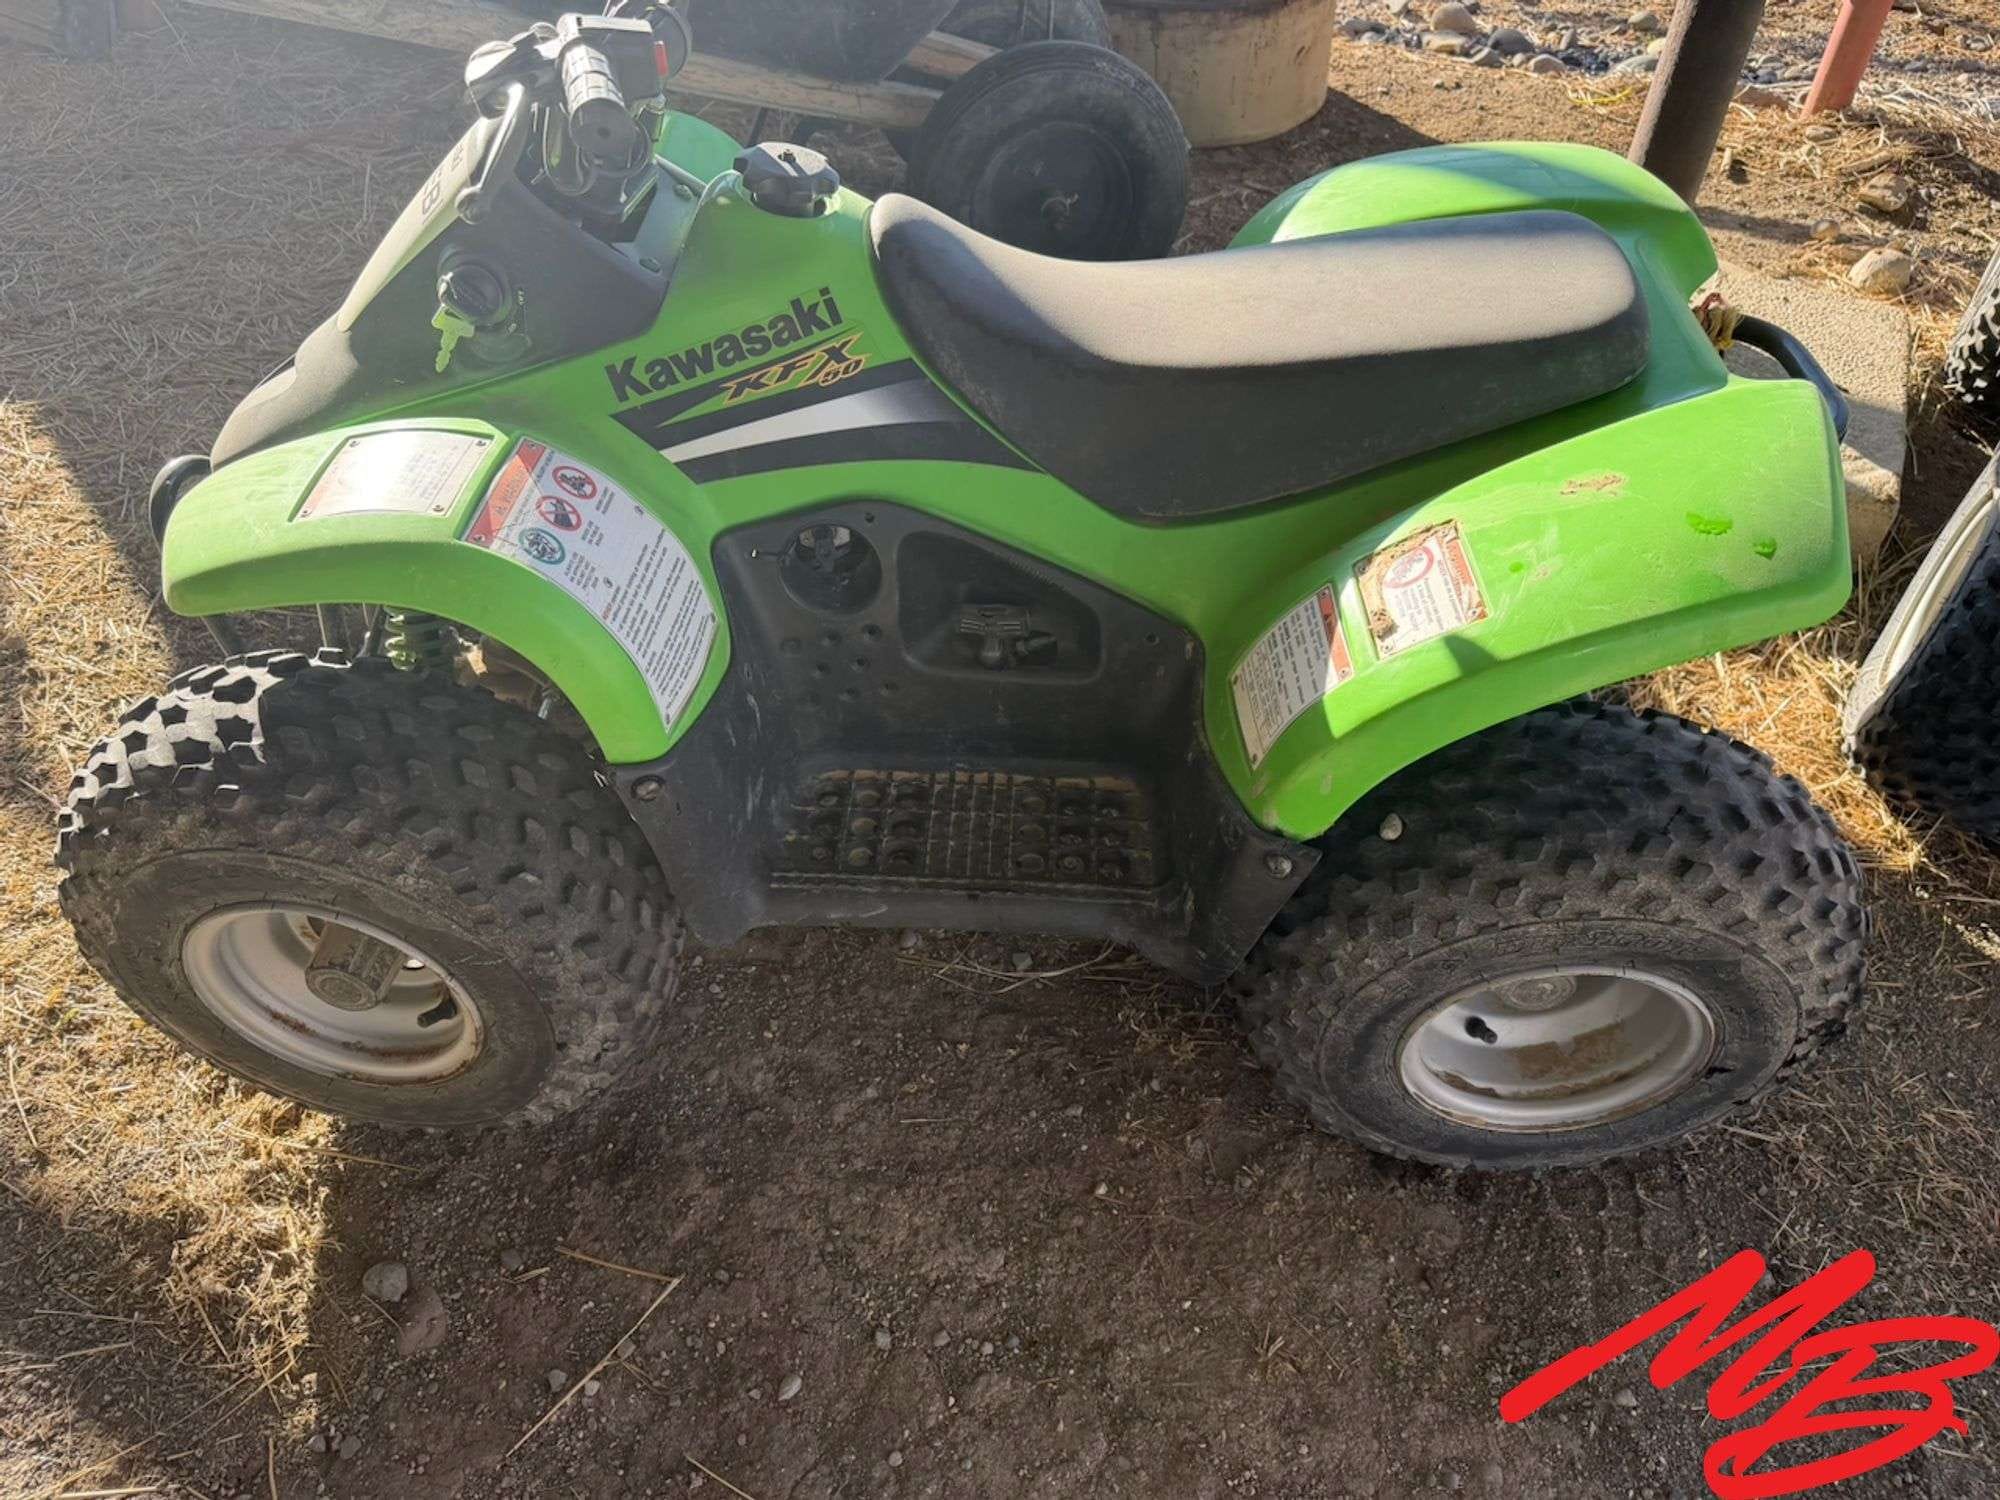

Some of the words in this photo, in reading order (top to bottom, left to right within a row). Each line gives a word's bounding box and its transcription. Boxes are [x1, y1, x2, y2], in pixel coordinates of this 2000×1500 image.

[604, 286, 843, 403] Kawasaki
[720, 331, 865, 405] KFX
[819, 354, 873, 387] 50
